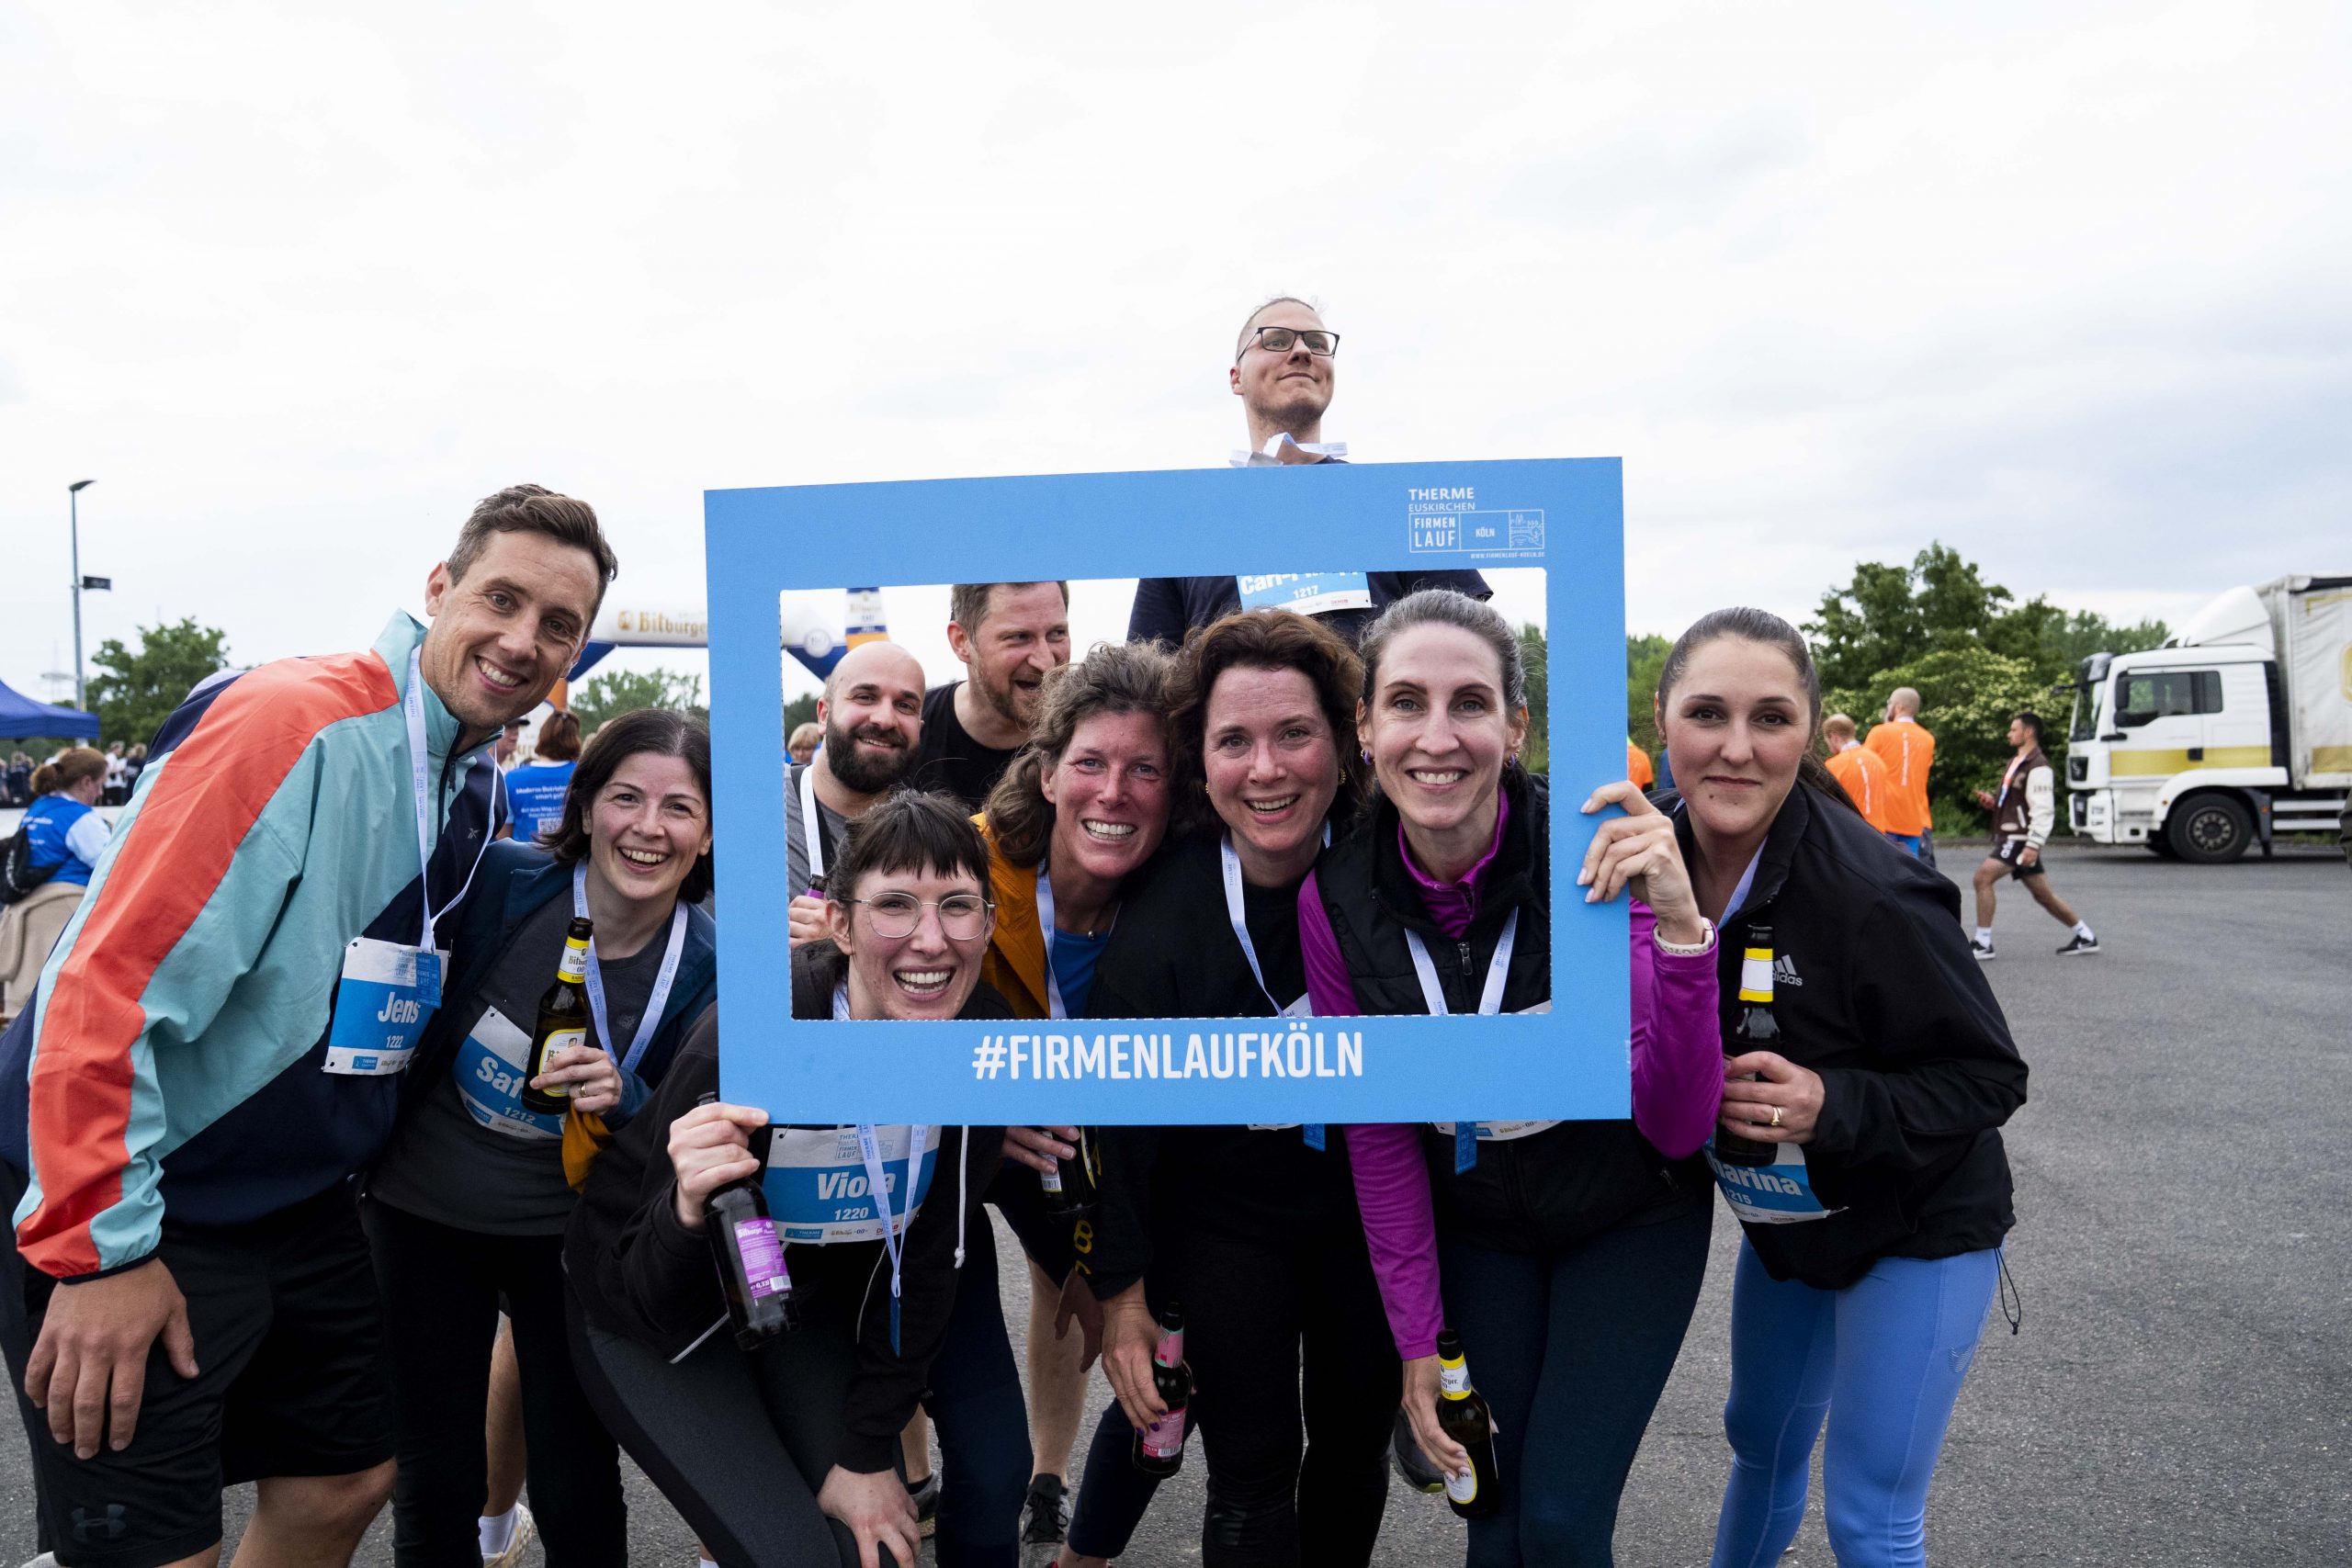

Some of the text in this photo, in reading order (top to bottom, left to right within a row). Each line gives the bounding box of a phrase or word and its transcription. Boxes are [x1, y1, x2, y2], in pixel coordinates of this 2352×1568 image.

[1408, 488, 1475, 501] THERME
[1408, 502, 1476, 513] EUSKIRCHEN
[1415, 517, 1455, 529] FIRMEN
[1415, 531, 1455, 547] LAUF
[1476, 527, 1495, 537] KÖLN
[1293, 585, 1318, 599] 1217
[639, 611, 707, 637] Bitburge
[1773, 970, 1803, 986] didas
[378, 991, 421, 1024] Jens
[386, 1035, 404, 1049] 1222
[972, 1021, 1363, 1080] #FIRMENLAUFKÖLN
[476, 1056, 525, 1100] Saf
[504, 1106, 536, 1124] 1212
[818, 1171, 896, 1201] Vioa
[834, 1206, 869, 1221] 1220
